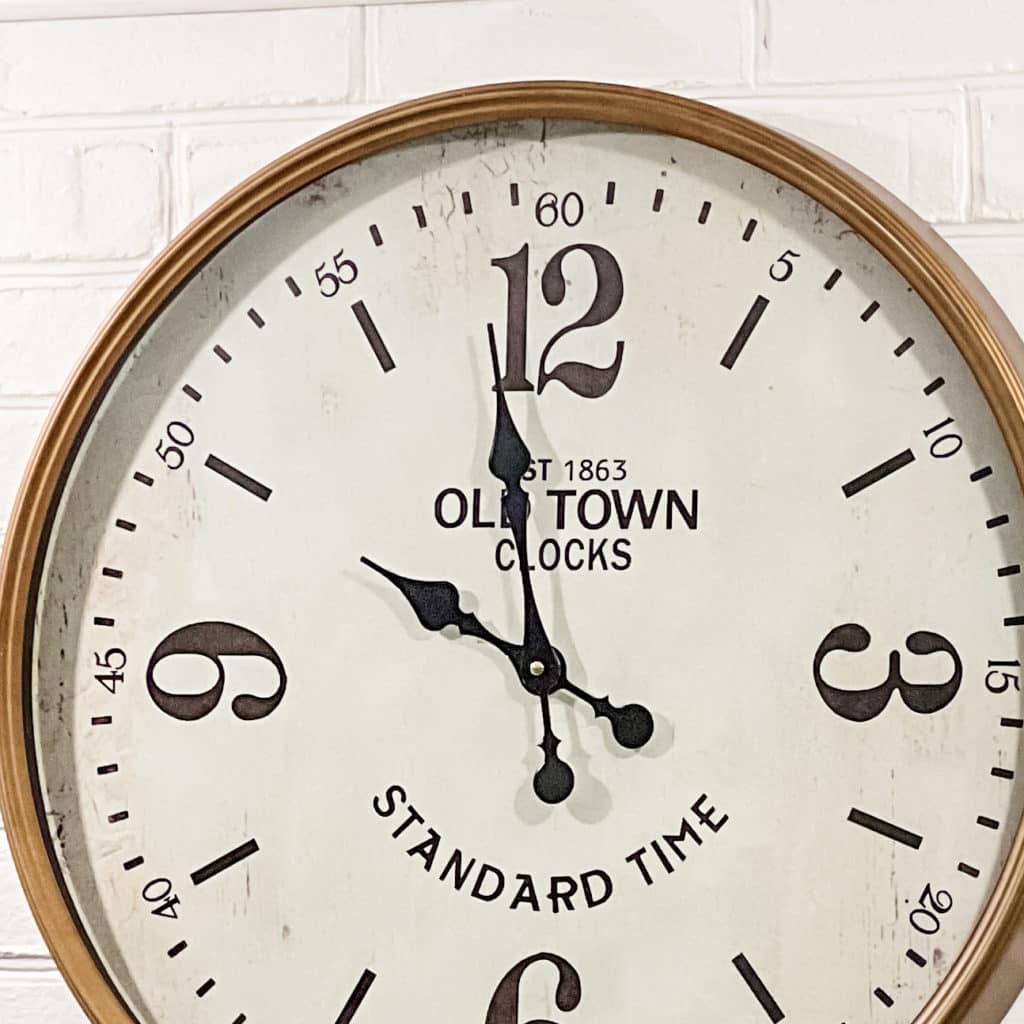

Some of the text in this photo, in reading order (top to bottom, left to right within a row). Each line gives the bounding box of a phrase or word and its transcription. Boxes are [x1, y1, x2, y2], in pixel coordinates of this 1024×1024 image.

[535, 191, 584, 228] 60
[314, 249, 359, 299] 55
[769, 249, 801, 282] 5
[490, 242, 625, 399] 12
[155, 421, 195, 470] 50
[922, 416, 964, 459] 10
[514, 457, 627, 482] ST 1863
[545, 488, 700, 531] TOWN
[495, 537, 632, 572] COCKS
[93, 647, 127, 695] 45
[145, 620, 288, 722] 9
[812, 622, 964, 723] 3
[984, 659, 1022, 694] 15
[372, 784, 729, 914] STANDARD TIME
[141, 877, 181, 920] 40
[909, 882, 953, 935] 20
